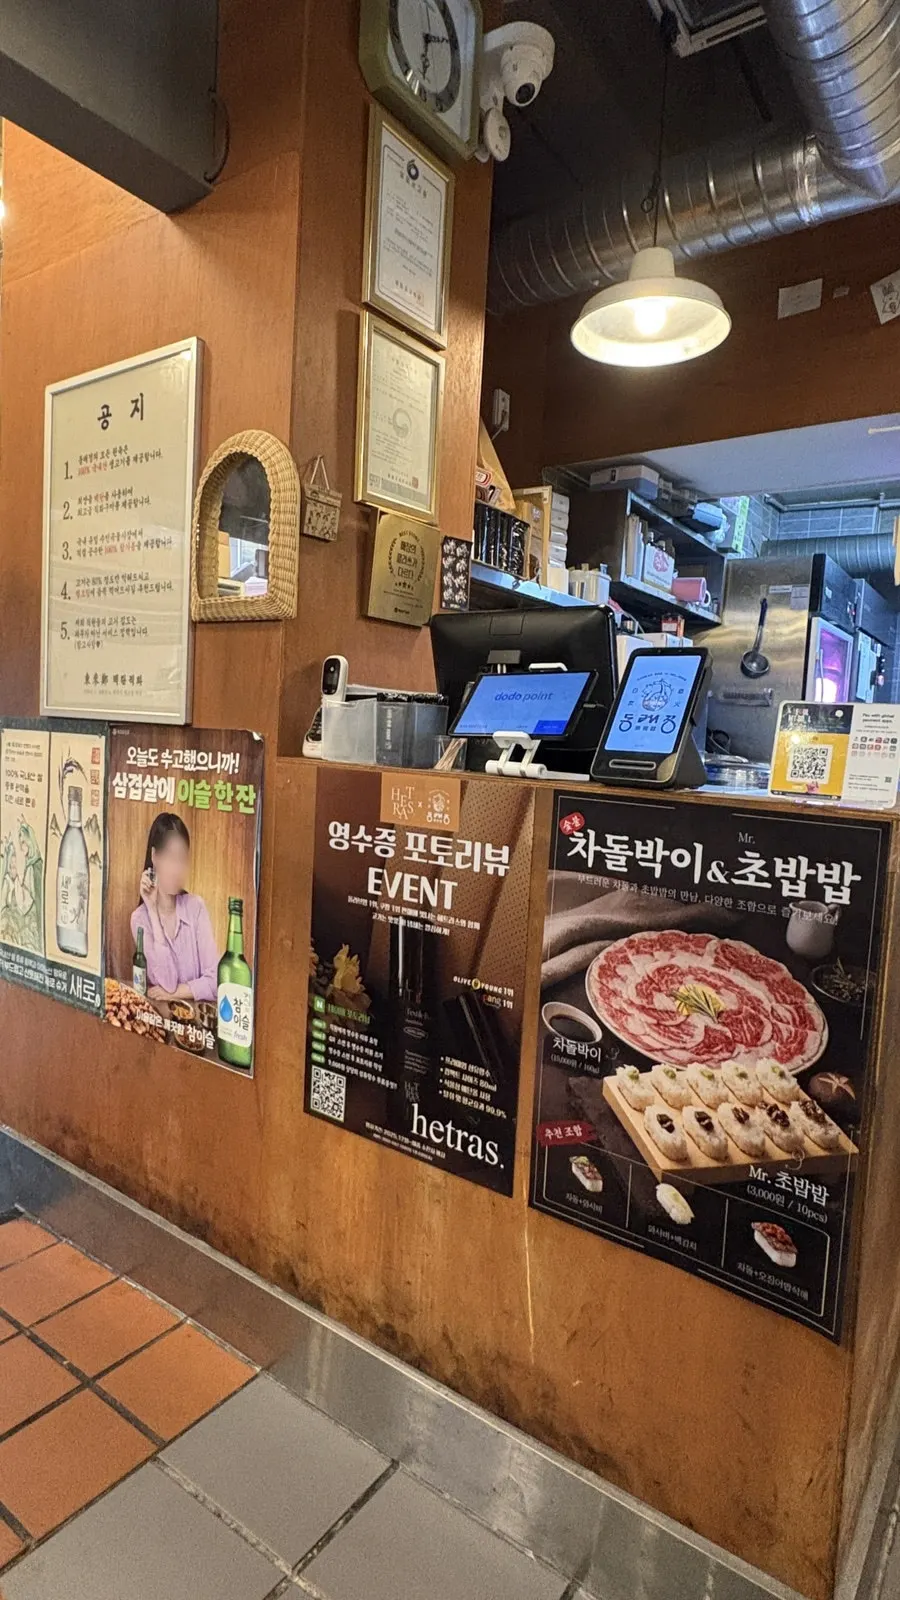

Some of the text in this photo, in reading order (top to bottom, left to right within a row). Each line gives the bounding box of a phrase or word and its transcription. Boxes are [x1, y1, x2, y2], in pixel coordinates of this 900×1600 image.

[64, 461, 73, 480] 1.
[63, 501, 73, 520] 2.
[62, 541, 72, 560] 3.
[61, 580, 71, 600] 4.
[61, 621, 70, 640] 5.
[494, 691, 554, 702] dodo point
[126, 746, 240, 775] 오늘도 수고했으니까!
[112, 771, 175, 804] 삼겹살에
[177, 779, 212, 809] 이슬
[213, 779, 234, 812] 한
[235, 783, 256, 814] 잔
[328, 821, 510, 877] 영수증 포토리뷰
[738, 832, 755, 844] Mr.
[367, 867, 458, 910] EVENT
[578, 874, 610, 888] 부드러운
[641, 885, 676, 898] 초밥밥의
[704, 895, 733, 908] 다양한
[737, 900, 777, 915] 조합으로
[69, 974, 95, 1003] 새로
[187, 1023, 215, 1050] 참이슬
[553, 1037, 601, 1062] 차돌박이
[411, 1103, 504, 1169] hetras.
[748, 1164, 830, 1206] Mr. 초밥밥
[746, 1184, 828, 1224] (3,000원 / 10pcs)
